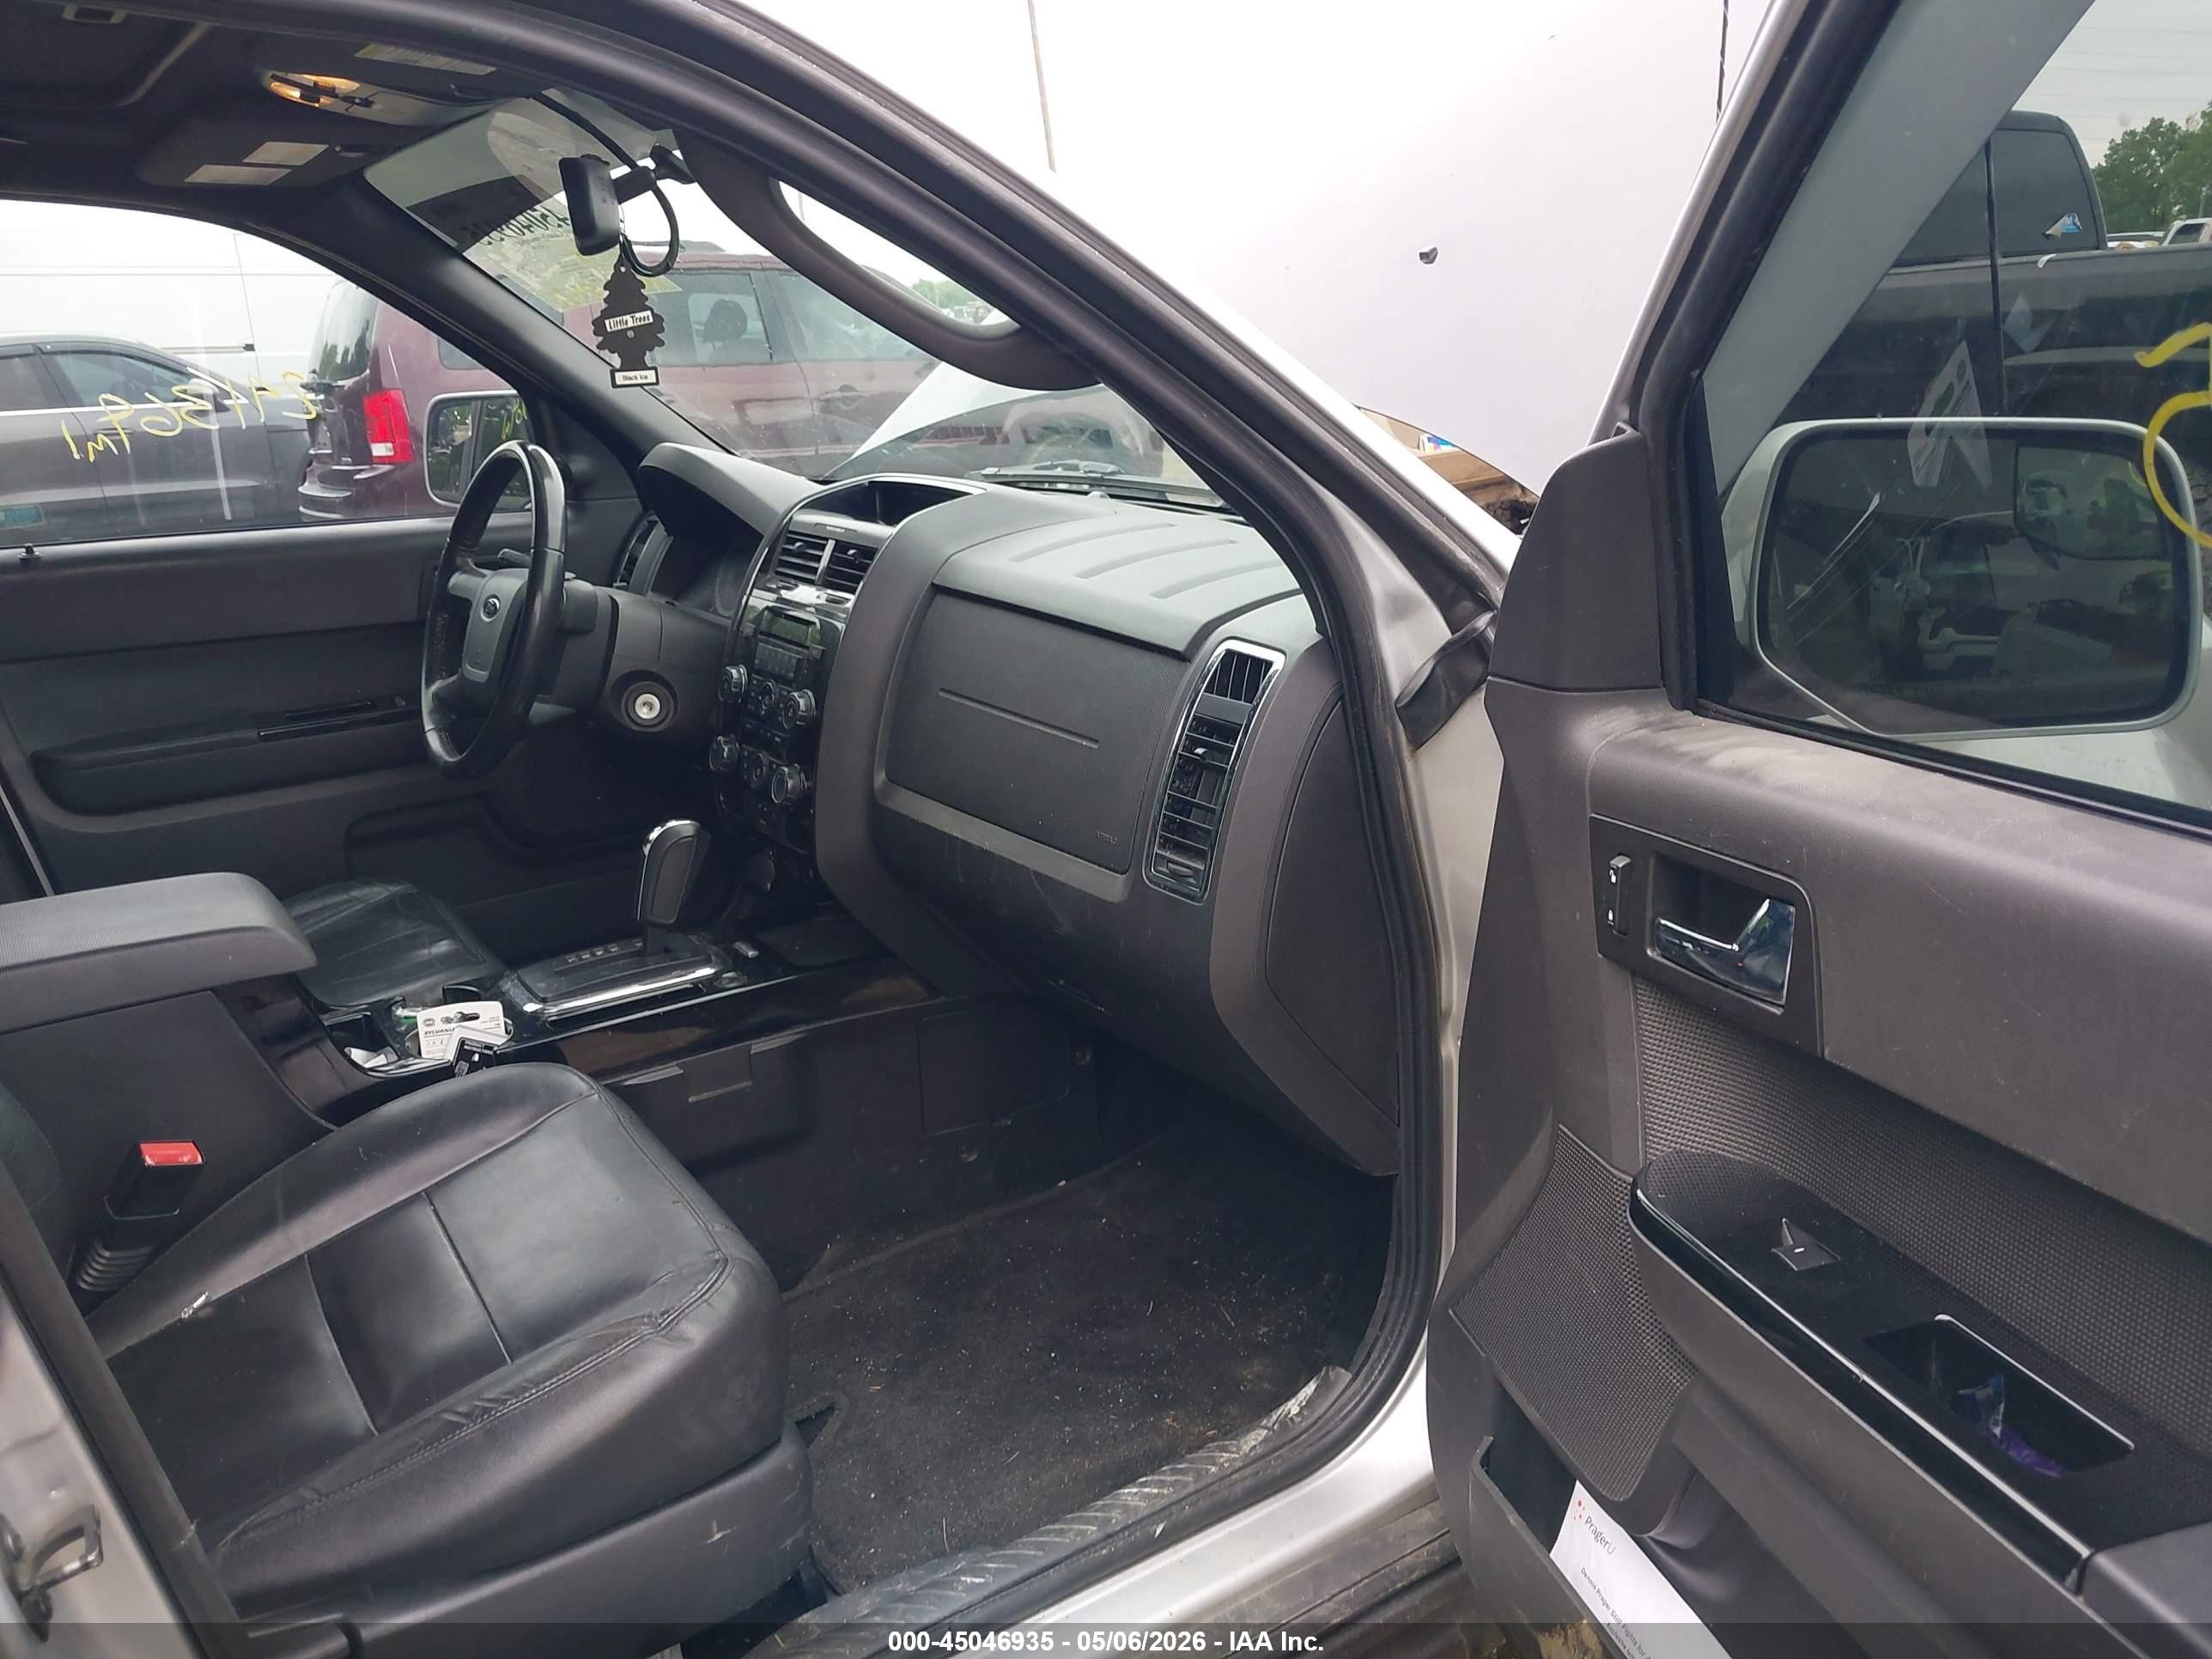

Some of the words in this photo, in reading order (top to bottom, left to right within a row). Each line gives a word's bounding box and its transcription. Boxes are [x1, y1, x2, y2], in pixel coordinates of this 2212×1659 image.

[608, 318, 629, 331] Little
[629, 314, 650, 325] Trees
[1585, 1516, 1616, 1555] PragerU
[1581, 1567, 1596, 1590] Dennis
[1596, 1588, 1611, 1612] Prager
[1611, 1608, 1622, 1625] Still
